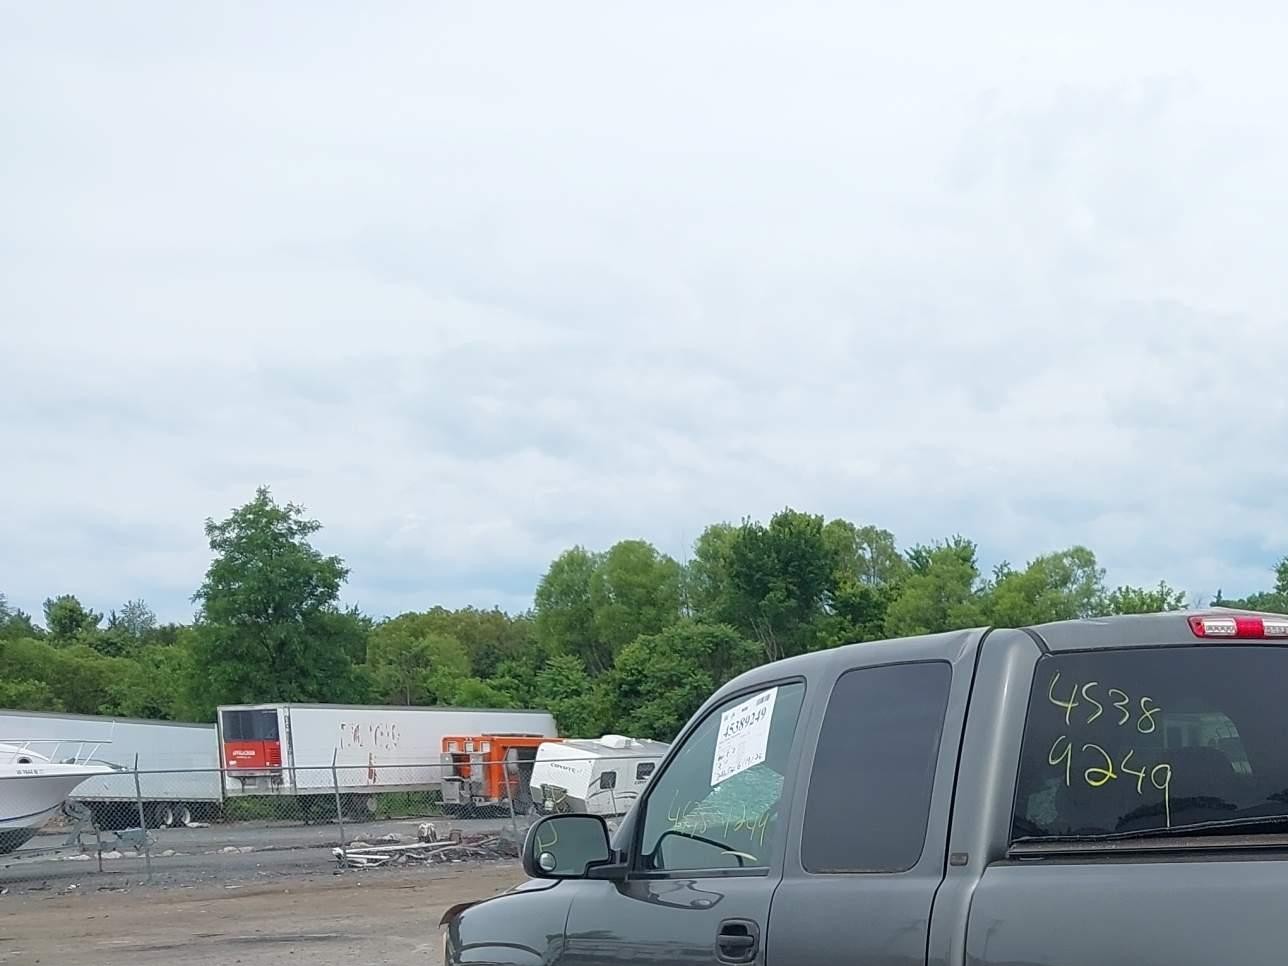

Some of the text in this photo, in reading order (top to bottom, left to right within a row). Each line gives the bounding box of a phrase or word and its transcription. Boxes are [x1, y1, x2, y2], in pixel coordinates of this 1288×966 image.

[722, 706, 768, 738] 45389249
[1049, 672, 1161, 733] 4538
[1048, 735, 1172, 828] 9249
